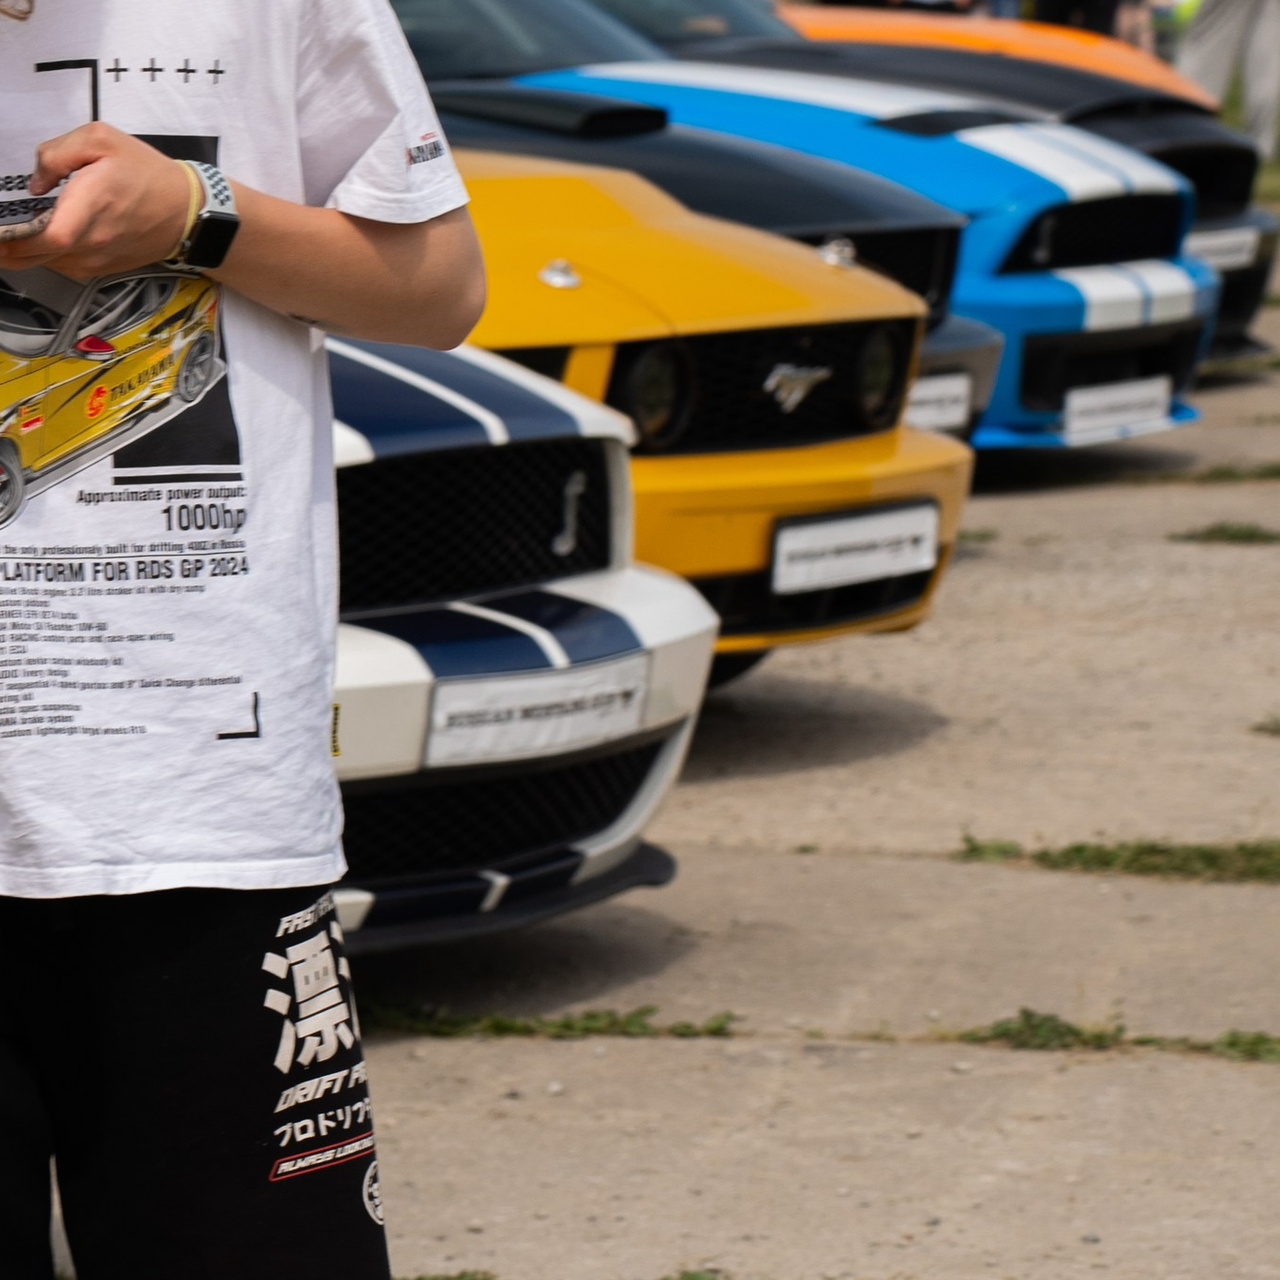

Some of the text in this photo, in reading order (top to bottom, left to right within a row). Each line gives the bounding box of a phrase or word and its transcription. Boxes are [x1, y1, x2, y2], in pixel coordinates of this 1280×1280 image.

[76, 489, 162, 506] Approximate
[167, 488, 203, 503] power
[161, 503, 247, 534] 1000hp
[149, 541, 184, 554] drifting
[93, 561, 129, 581] FOR
[136, 560, 175, 580] RDS
[181, 558, 205, 578] GP
[208, 556, 249, 577] 2024
[273, 1068, 350, 1114] DRIFT
